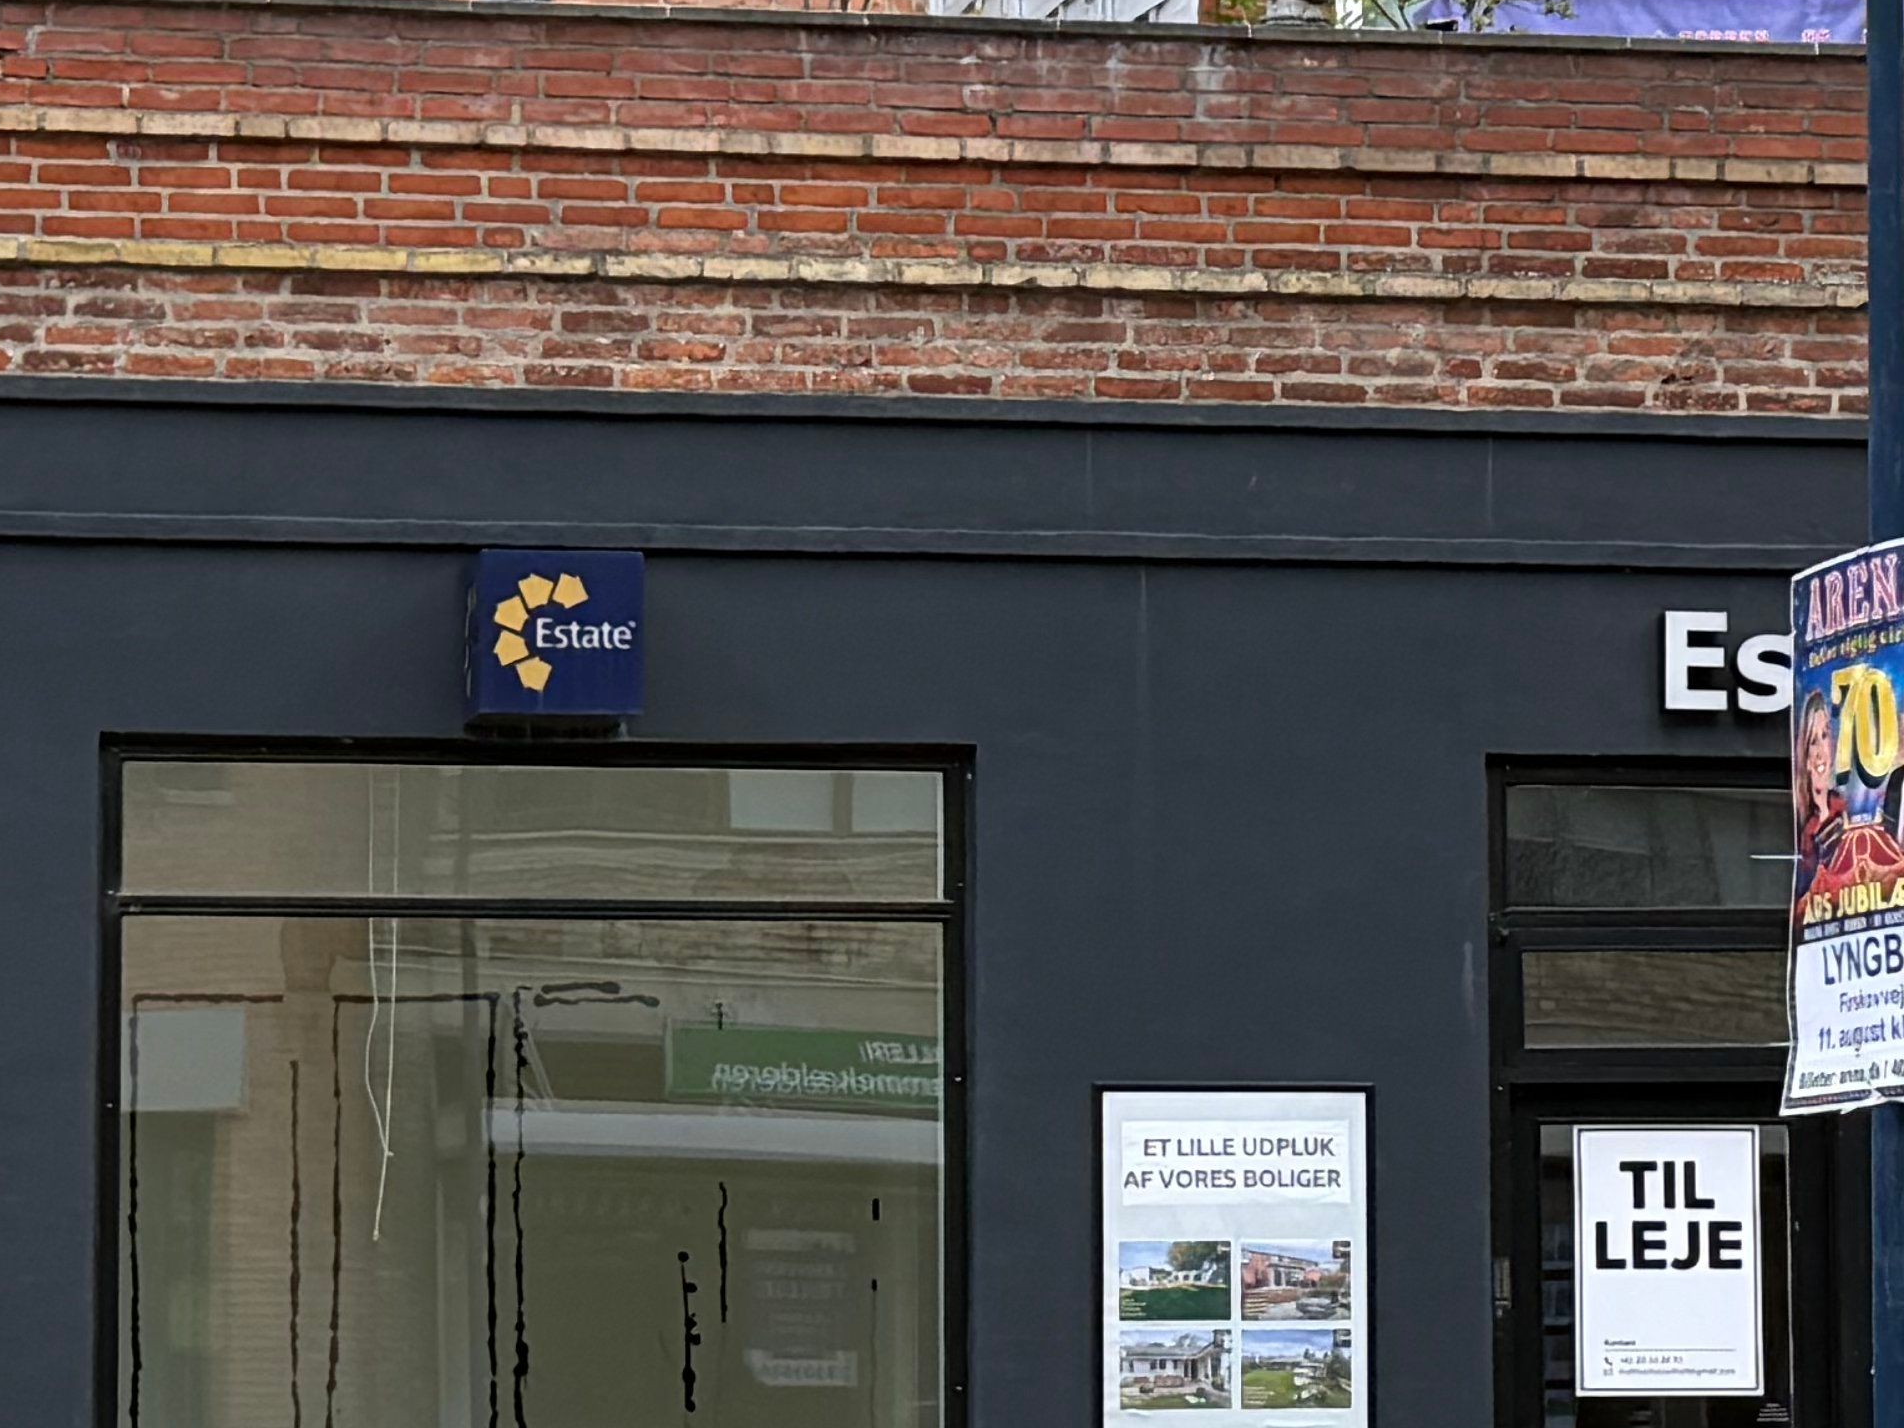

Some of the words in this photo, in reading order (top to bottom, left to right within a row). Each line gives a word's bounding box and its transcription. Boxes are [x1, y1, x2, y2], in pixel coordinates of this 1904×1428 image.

[536, 617, 633, 649] Estate
[1832, 663, 1899, 778] 70
[1818, 1026, 1836, 1052] 11.
[1839, 1017, 1886, 1051] august
[1143, 1138, 1172, 1157] ET
[1177, 1138, 1236, 1157] LILLE
[1242, 1138, 1335, 1157] UDPLUK
[1124, 1170, 1153, 1189] AF
[1158, 1169, 1237, 1189] VORES
[1243, 1169, 1342, 1189] BOLIGER
[1619, 1160, 1716, 1210] TIL
[1595, 1220, 1744, 1271] LEJE
